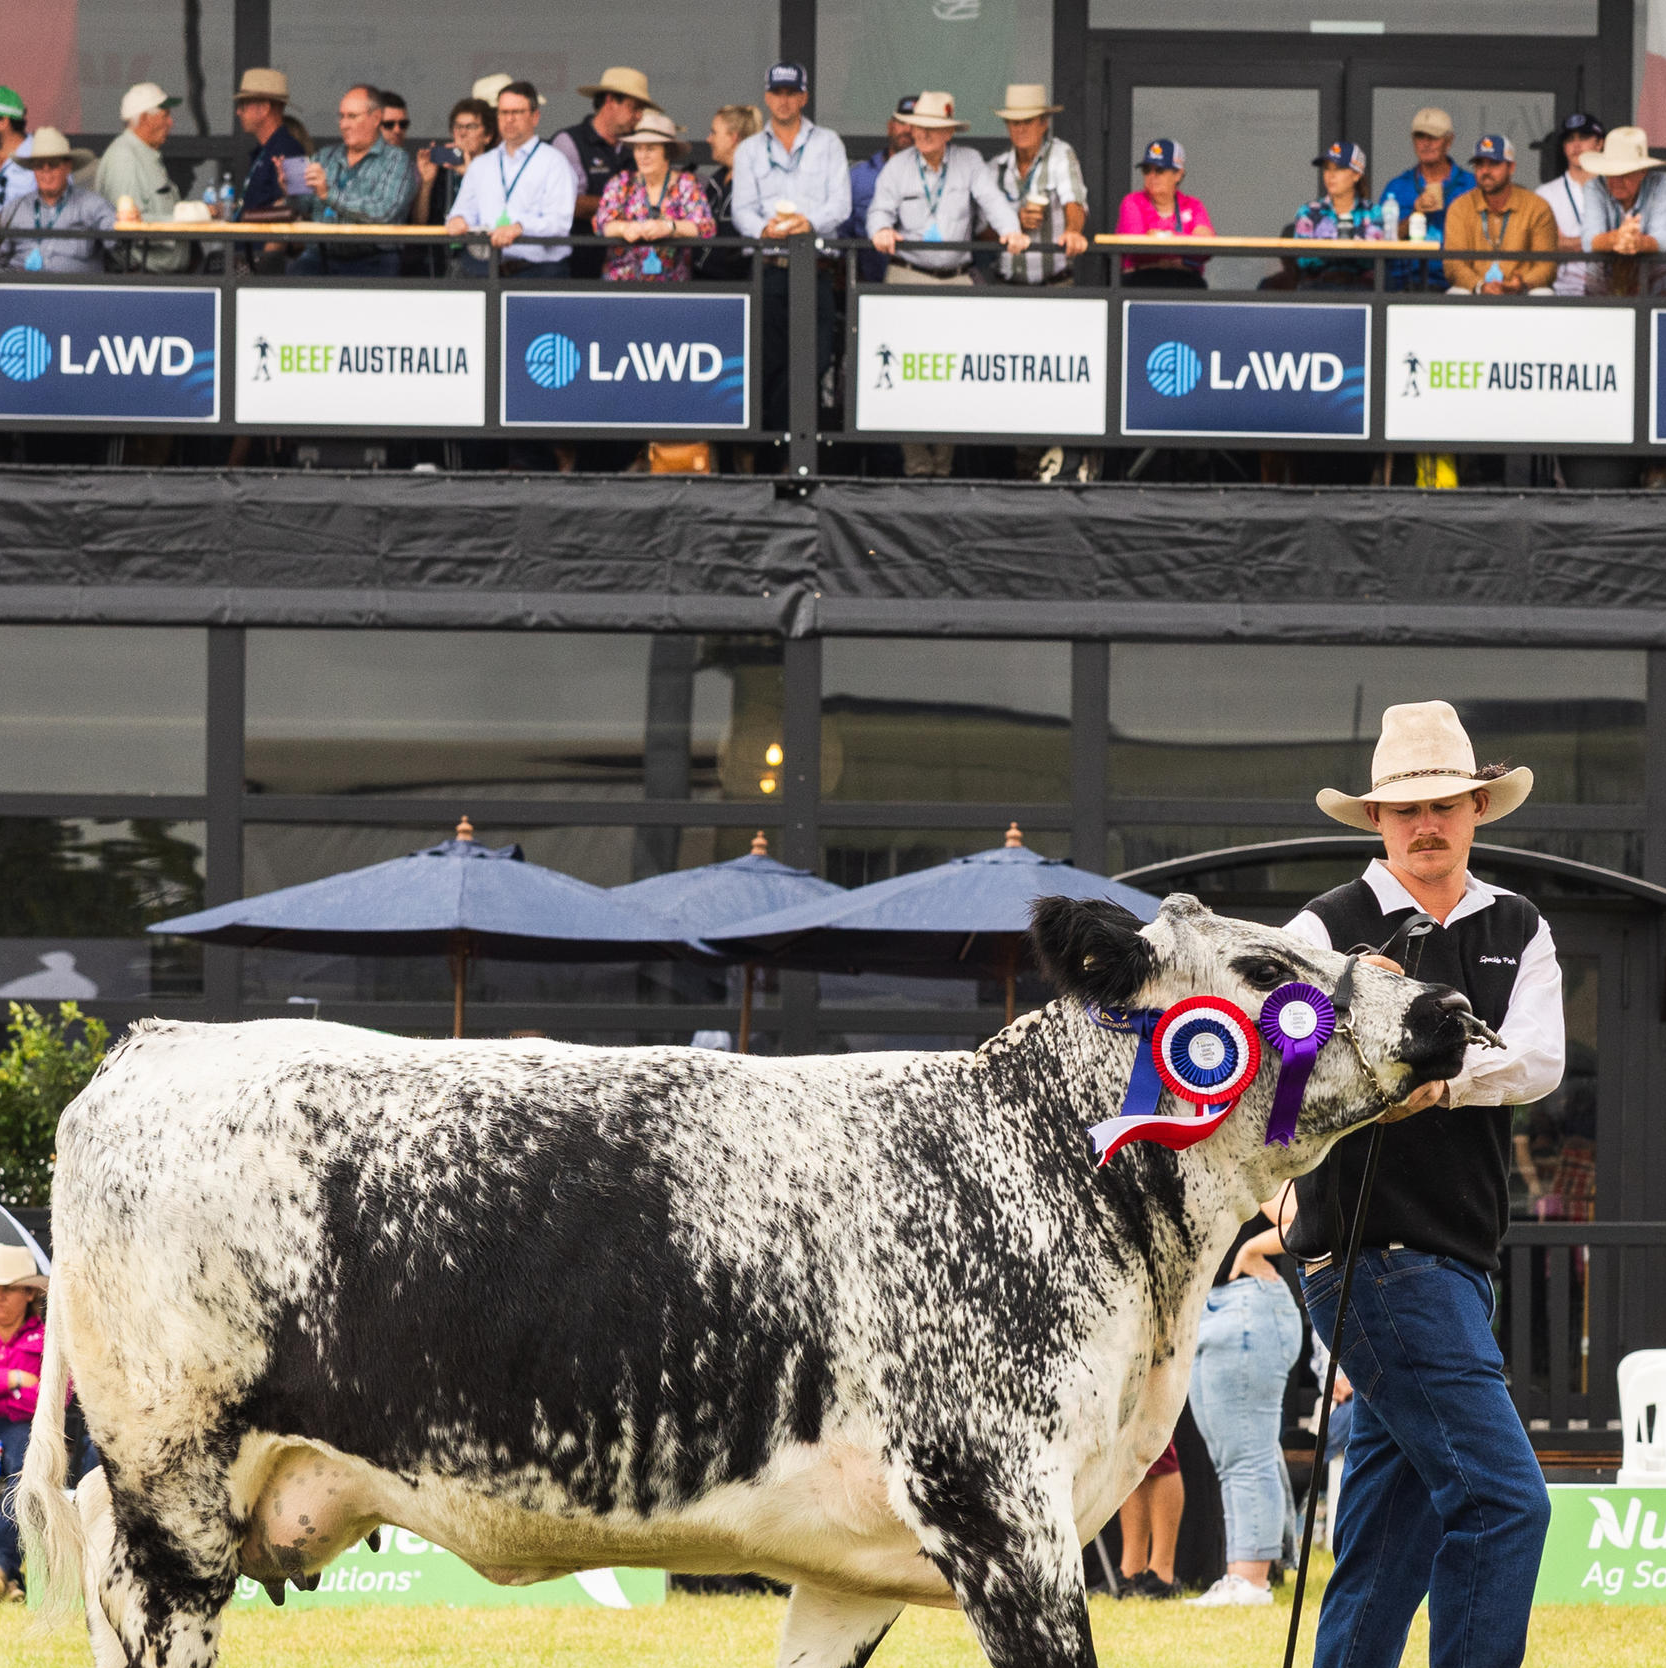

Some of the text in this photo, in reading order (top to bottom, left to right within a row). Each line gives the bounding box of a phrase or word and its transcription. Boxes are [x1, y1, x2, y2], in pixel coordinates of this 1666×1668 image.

[60, 335, 195, 376] LAWD
[280, 345, 468, 374] BEEF AUSTRALIA
[589, 342, 723, 382] LAWD
[902, 354, 1090, 382] BEEF AUSTRALIA
[1210, 351, 1343, 392] LAWD
[1430, 361, 1617, 391] BEEF AUSTRALIA
[1581, 1560, 1625, 1596] Ag
